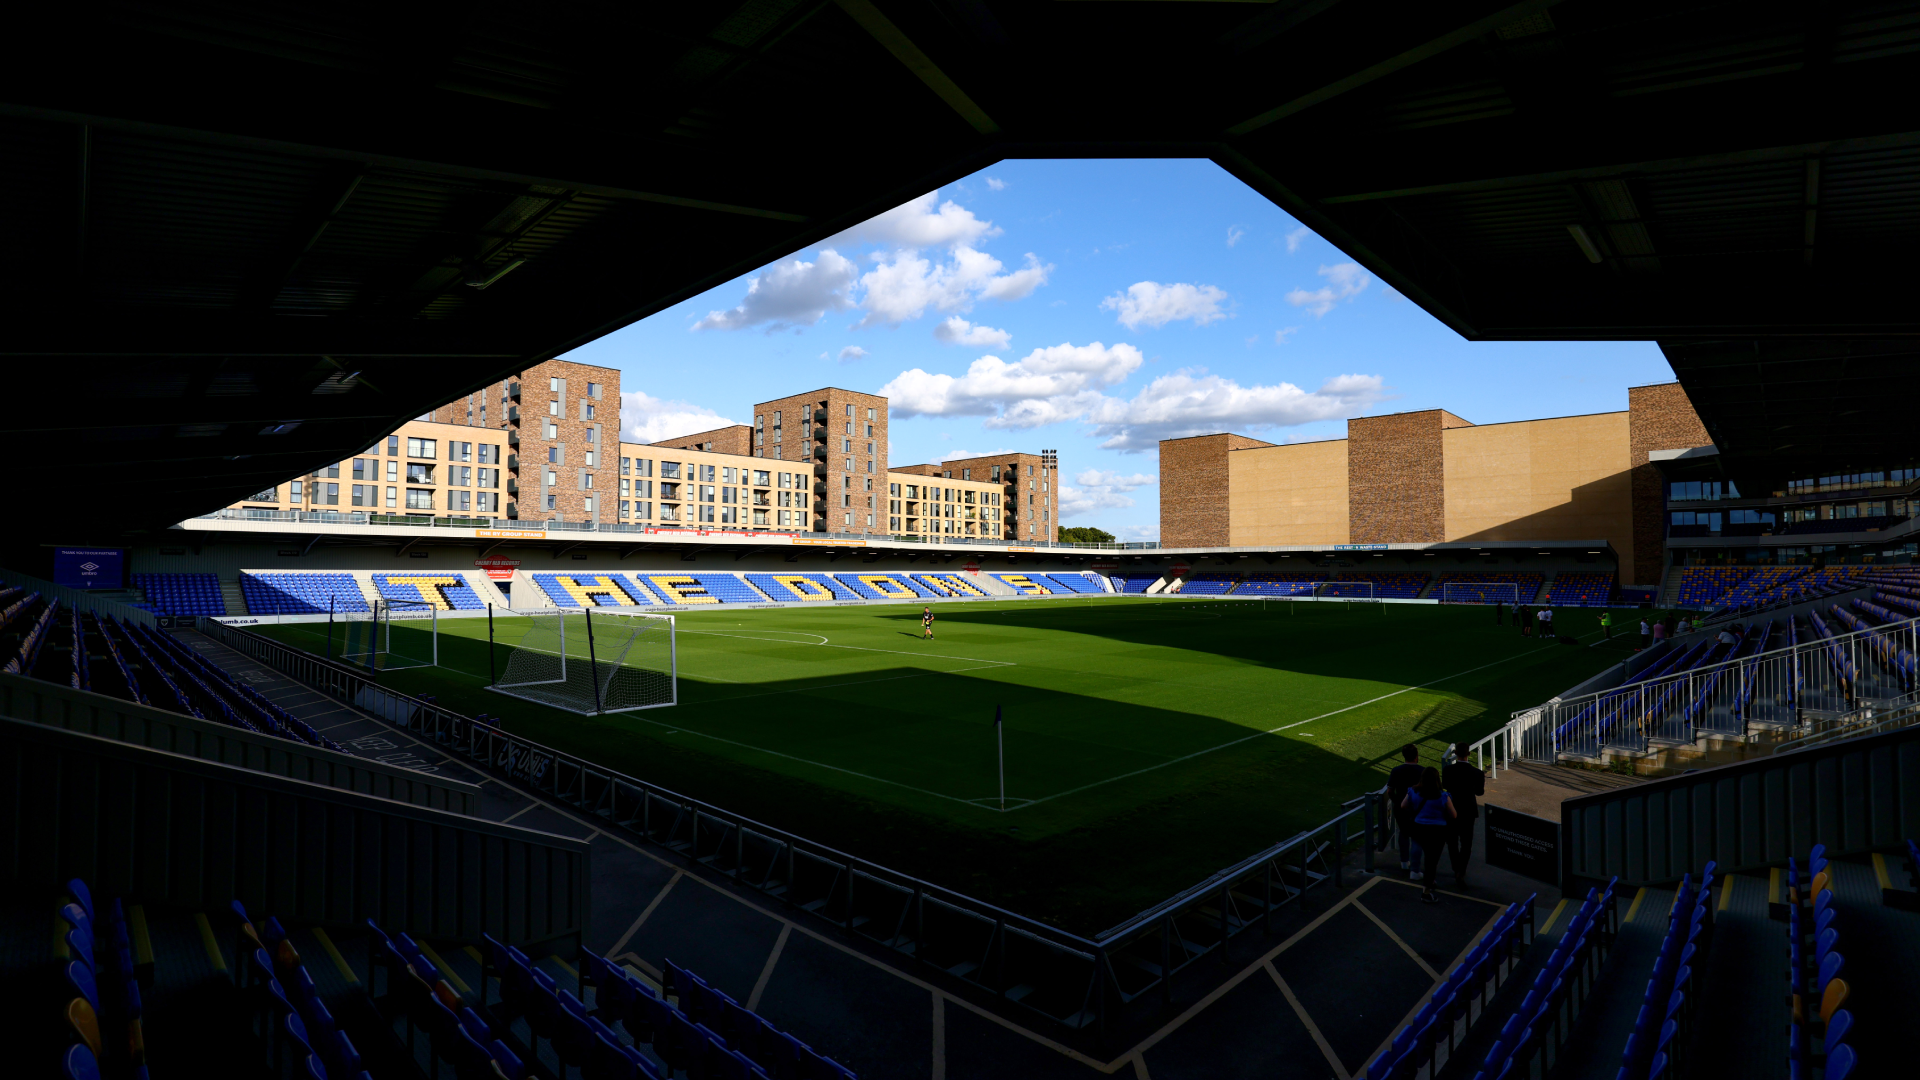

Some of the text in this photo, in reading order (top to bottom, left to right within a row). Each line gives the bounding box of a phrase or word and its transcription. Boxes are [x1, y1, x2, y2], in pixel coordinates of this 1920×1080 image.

[1495, 832, 1548, 853] BEYOND THESE GATES.
[1497, 827, 1534, 842] UNAUTHORISED
[1535, 838, 1554, 849] ACCESS
[1506, 847, 1523, 857] THANK
